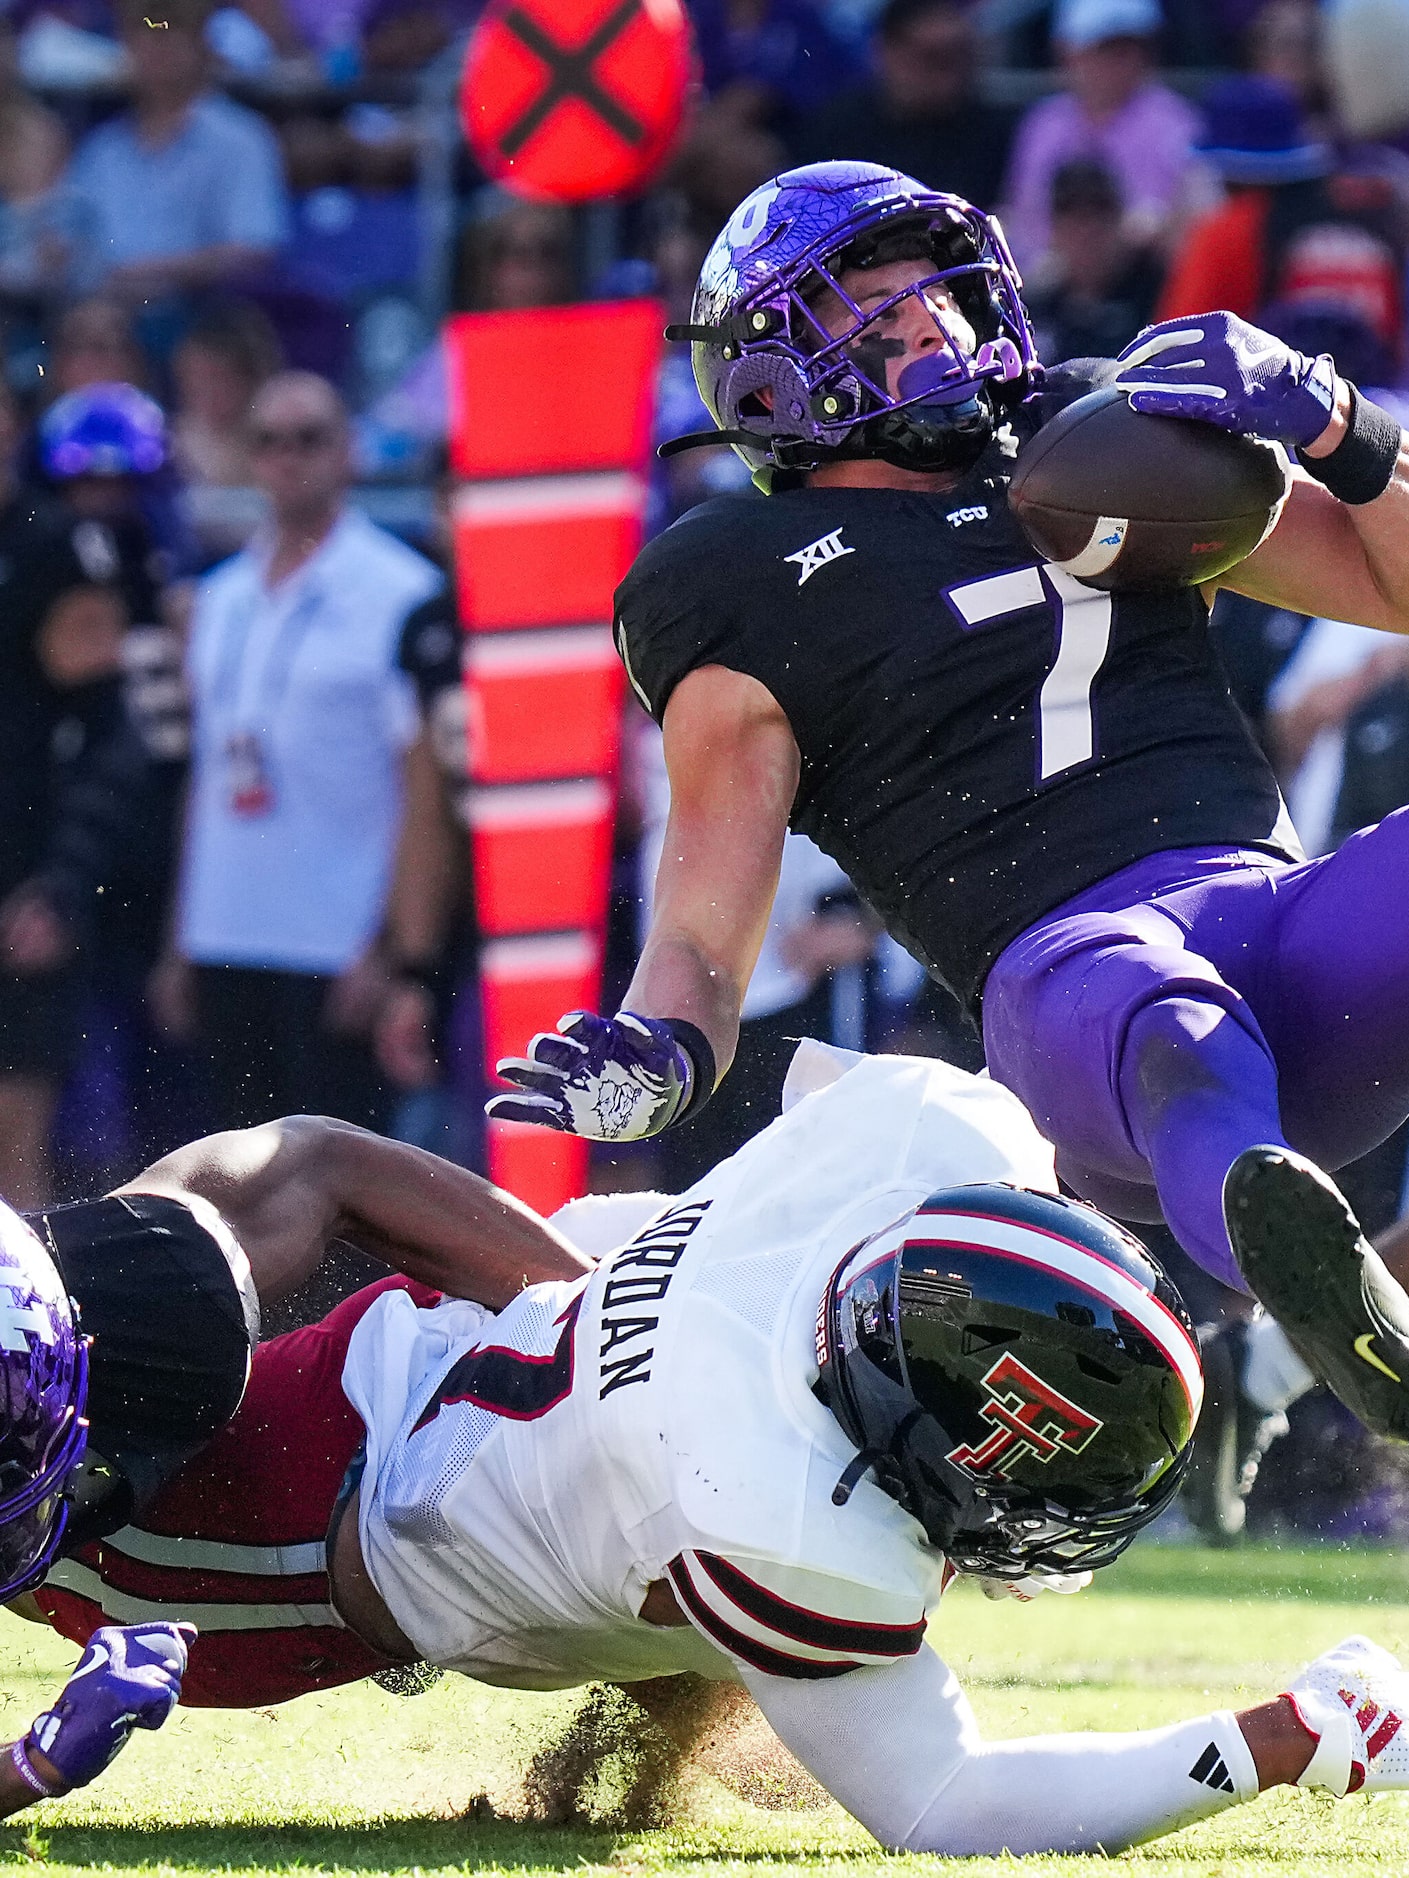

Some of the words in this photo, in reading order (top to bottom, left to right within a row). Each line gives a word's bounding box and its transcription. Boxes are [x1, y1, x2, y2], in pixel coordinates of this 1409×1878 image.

[783, 526, 856, 587] XII
[946, 504, 989, 528] TCU
[941, 562, 1113, 780] 7
[599, 1199, 714, 1400] JORDAN
